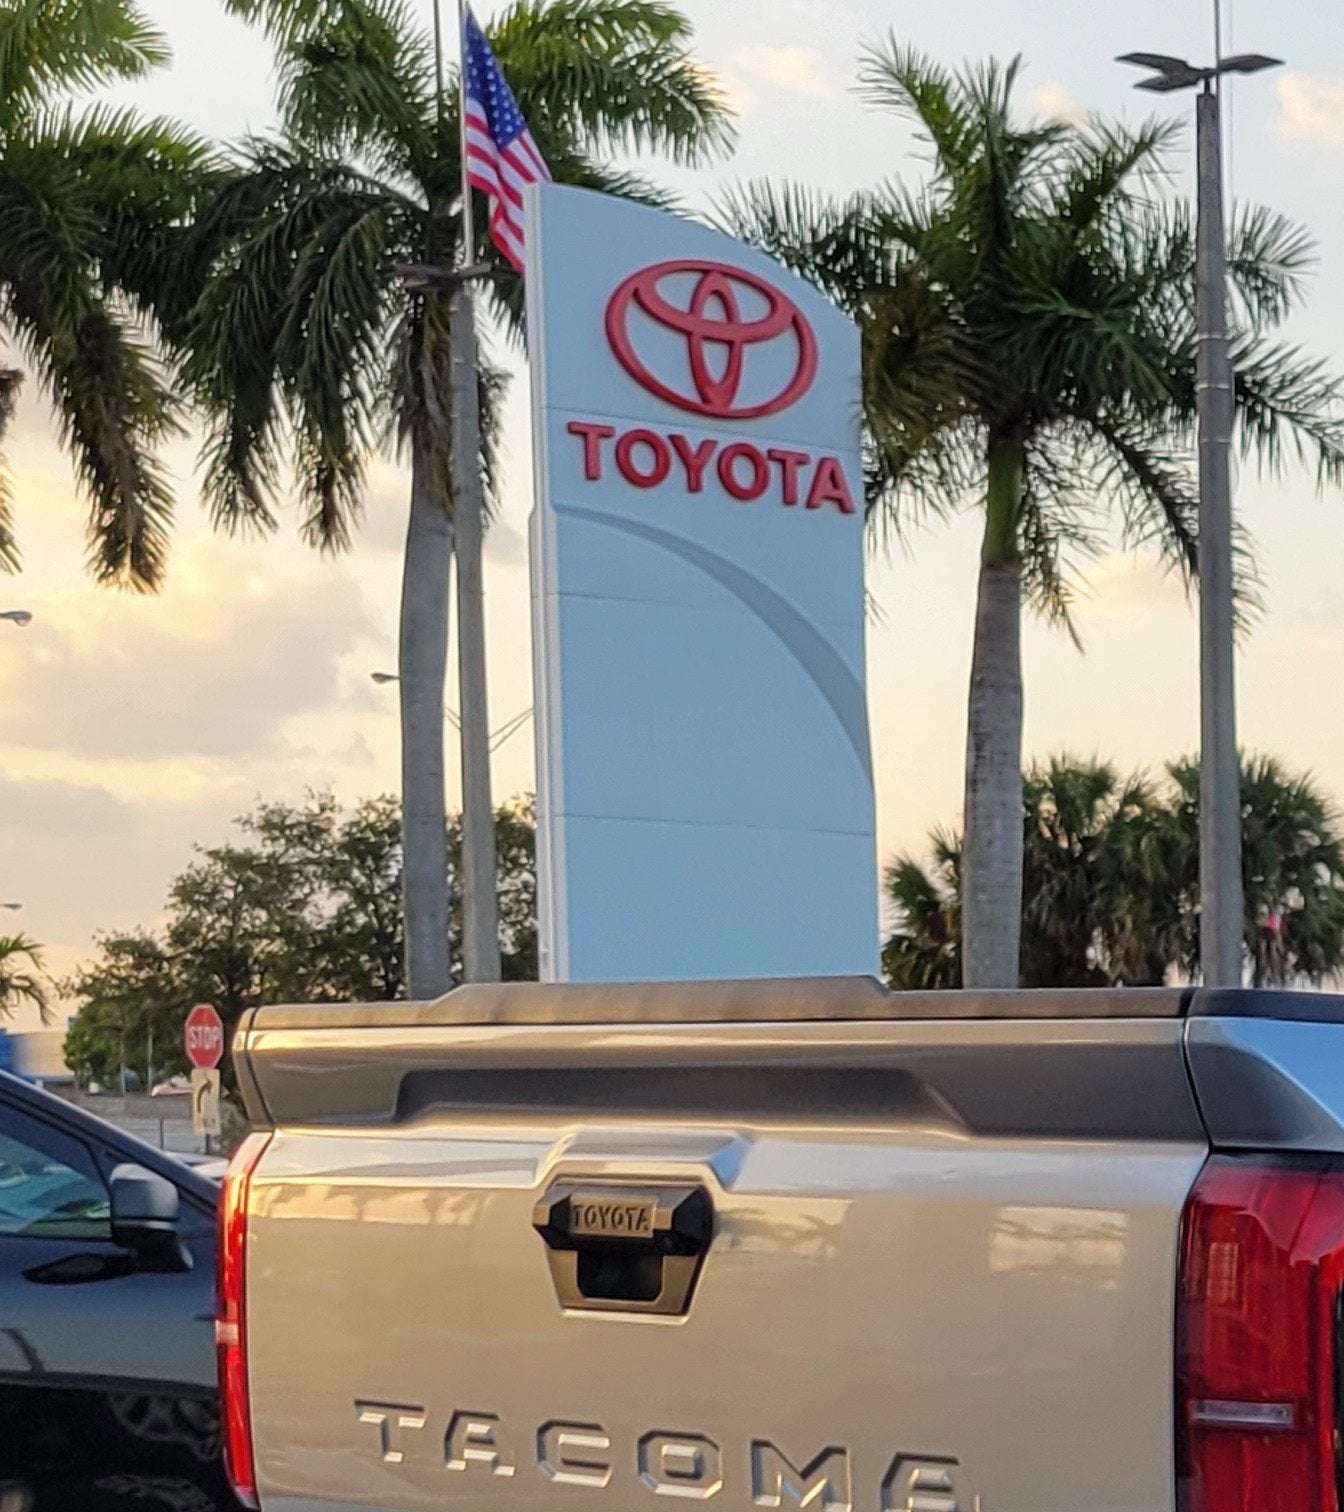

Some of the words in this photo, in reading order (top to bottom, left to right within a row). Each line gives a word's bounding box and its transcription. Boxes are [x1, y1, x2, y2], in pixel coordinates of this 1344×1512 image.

[567, 421, 855, 514] TOYOTA
[189, 1025, 220, 1050] STOP
[572, 1204, 650, 1232] TOYOTA
